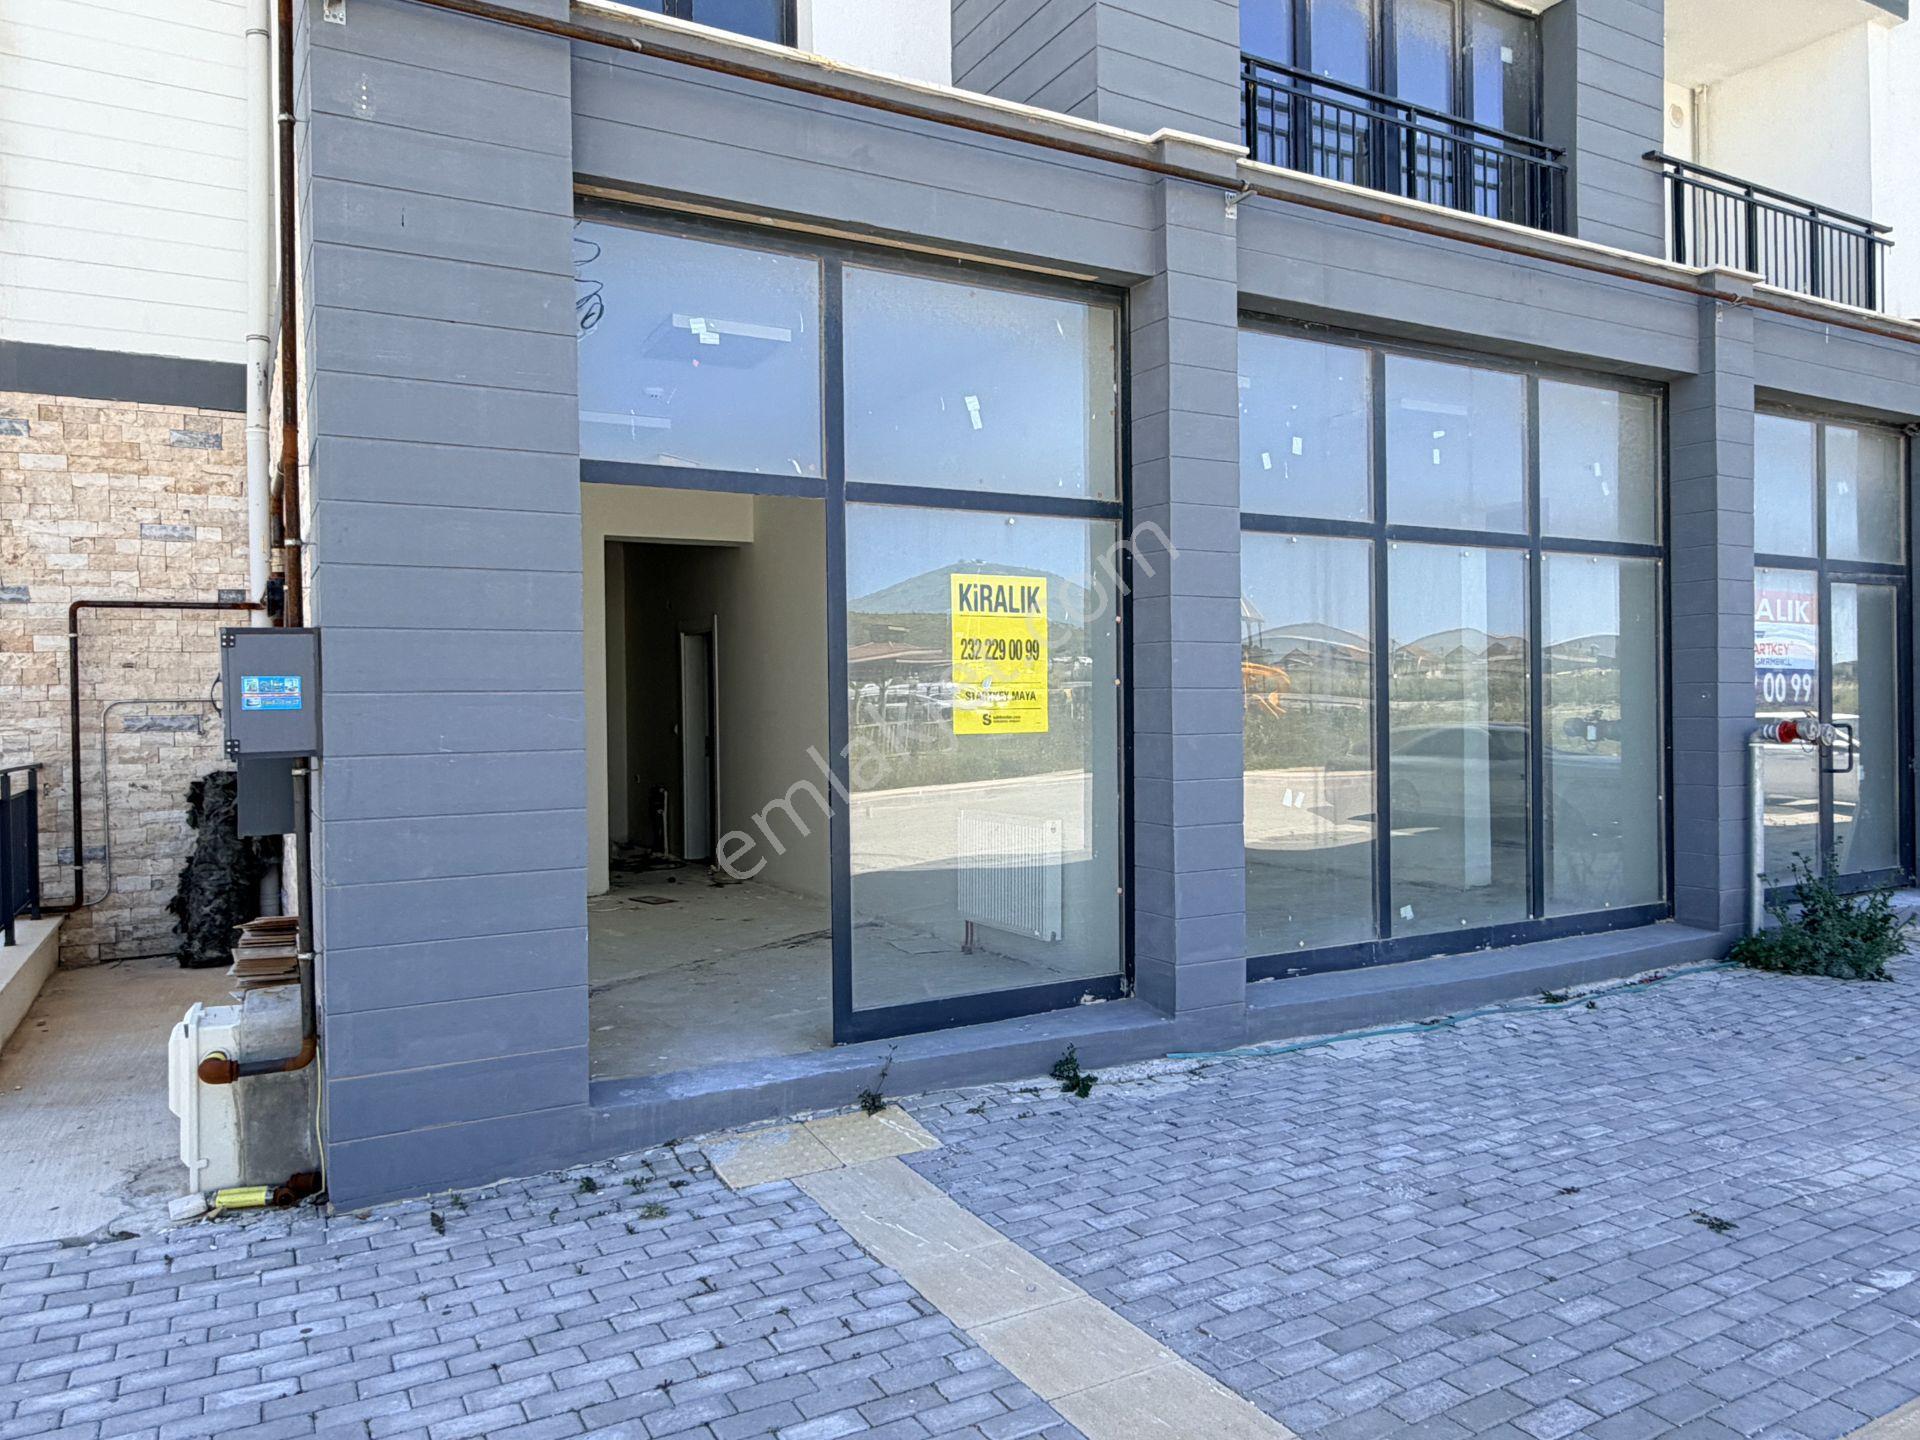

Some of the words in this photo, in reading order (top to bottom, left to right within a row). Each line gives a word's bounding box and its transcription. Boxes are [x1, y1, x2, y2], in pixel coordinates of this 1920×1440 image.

[960, 638, 982, 661] 232
[985, 638, 1006, 661] 229
[1008, 639, 1022, 661] 00
[1025, 639, 1040, 661] 99
[1012, 690, 1037, 701] MAYA
[1763, 672, 1786, 703] 00
[1791, 673, 1812, 702] 99
